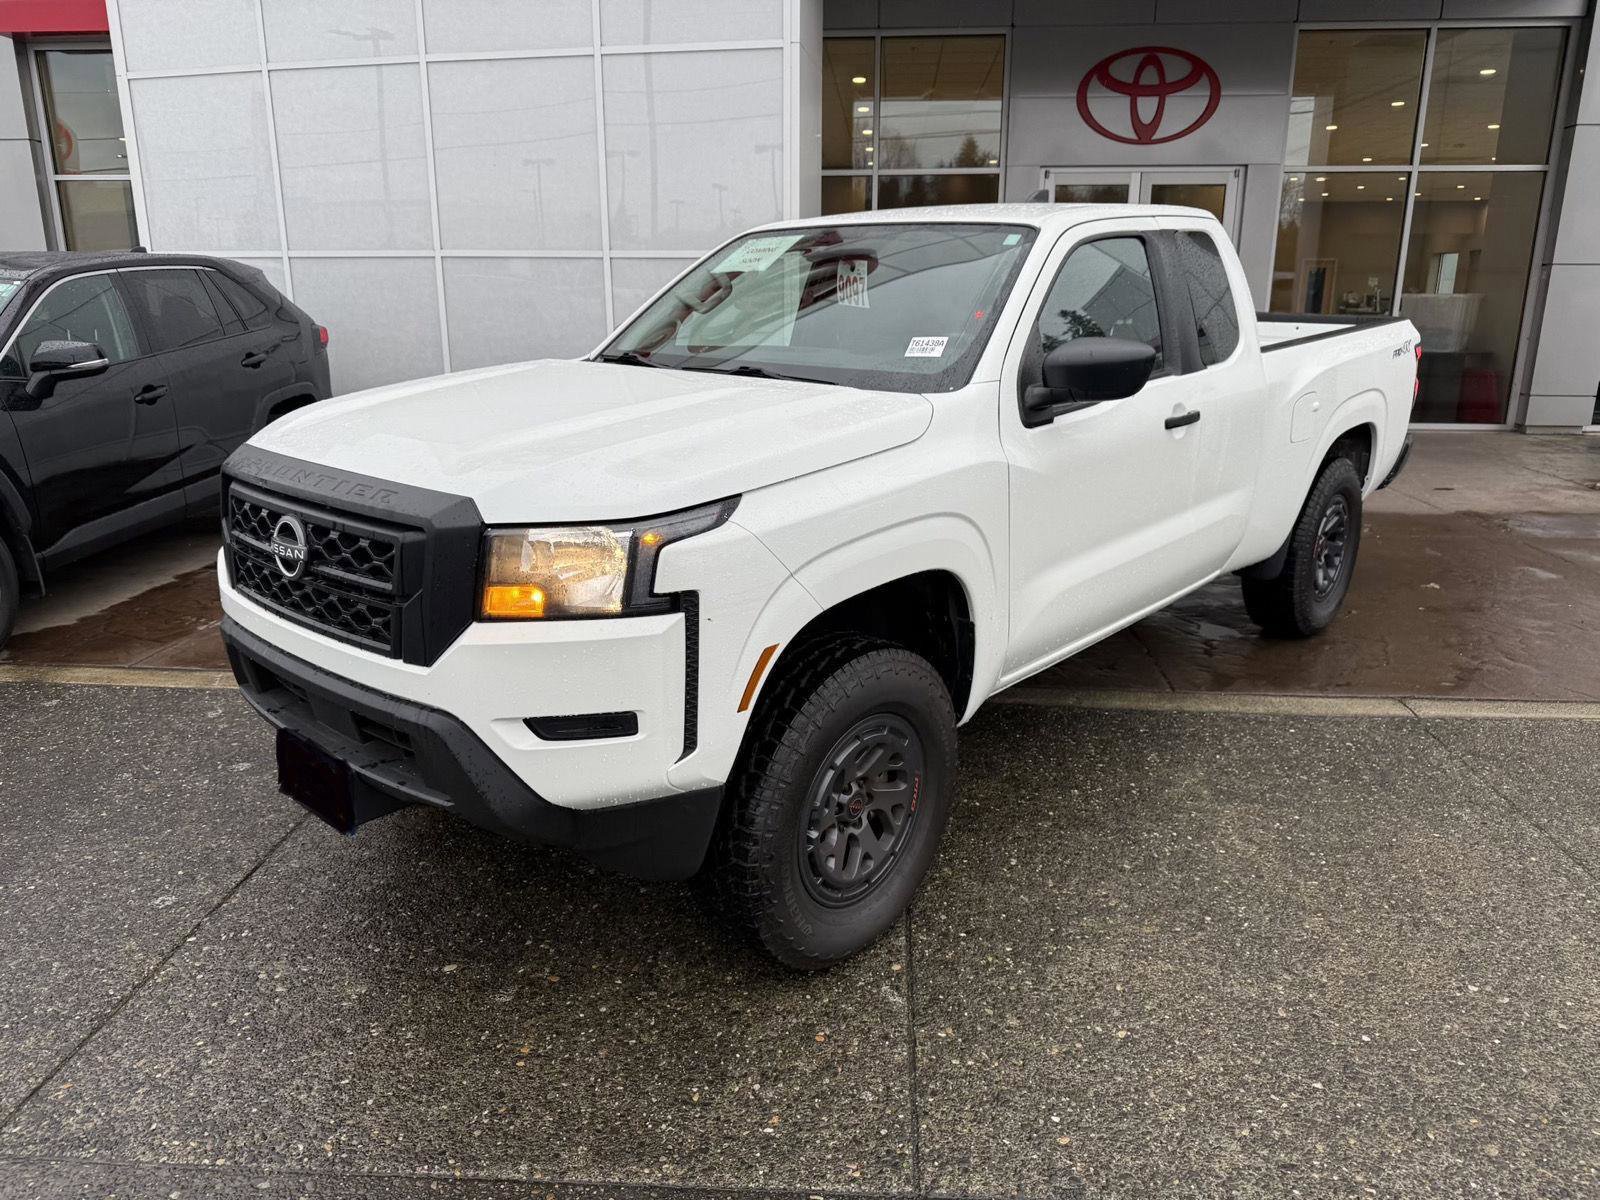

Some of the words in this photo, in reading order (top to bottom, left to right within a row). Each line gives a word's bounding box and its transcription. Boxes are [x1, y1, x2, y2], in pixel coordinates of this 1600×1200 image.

[838, 274, 865, 306] 9097
[236, 456, 398, 504] ONTIER
[272, 542, 304, 560] SSAN
